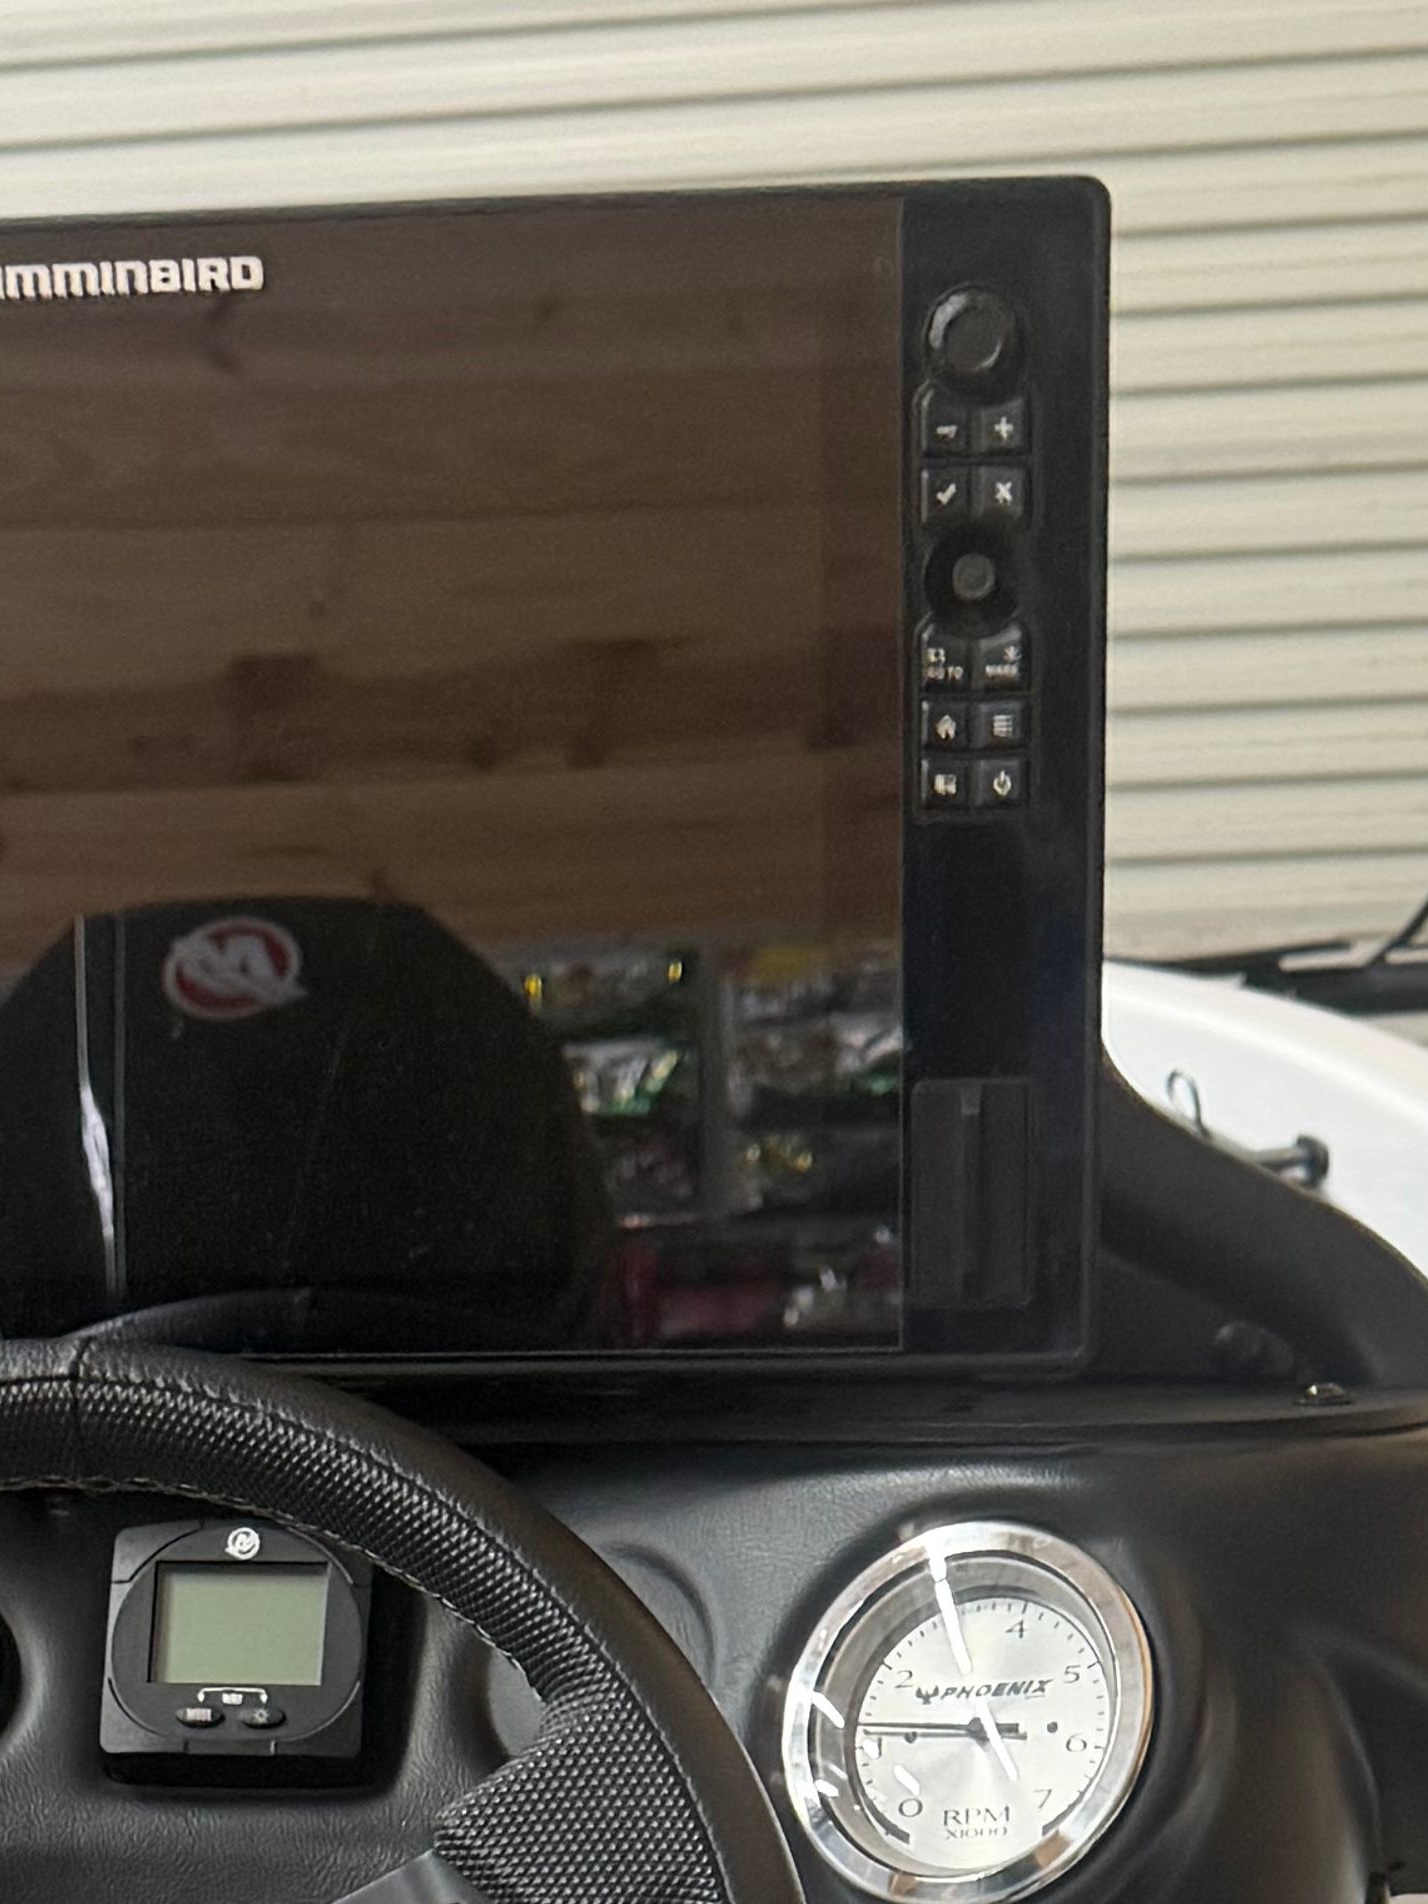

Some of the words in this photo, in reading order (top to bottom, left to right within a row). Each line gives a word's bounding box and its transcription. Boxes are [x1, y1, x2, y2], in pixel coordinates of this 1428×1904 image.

[1005, 1618, 1027, 1639] 4
[894, 1669, 914, 1689] 2
[1063, 1664, 1081, 1684] 5
[940, 1678, 1053, 1700] PHOENIX
[1065, 1735, 1088, 1753] 6
[897, 1798, 924, 1818] 0
[1034, 1788, 1053, 1809] 7
[943, 1805, 1011, 1827] RPM
